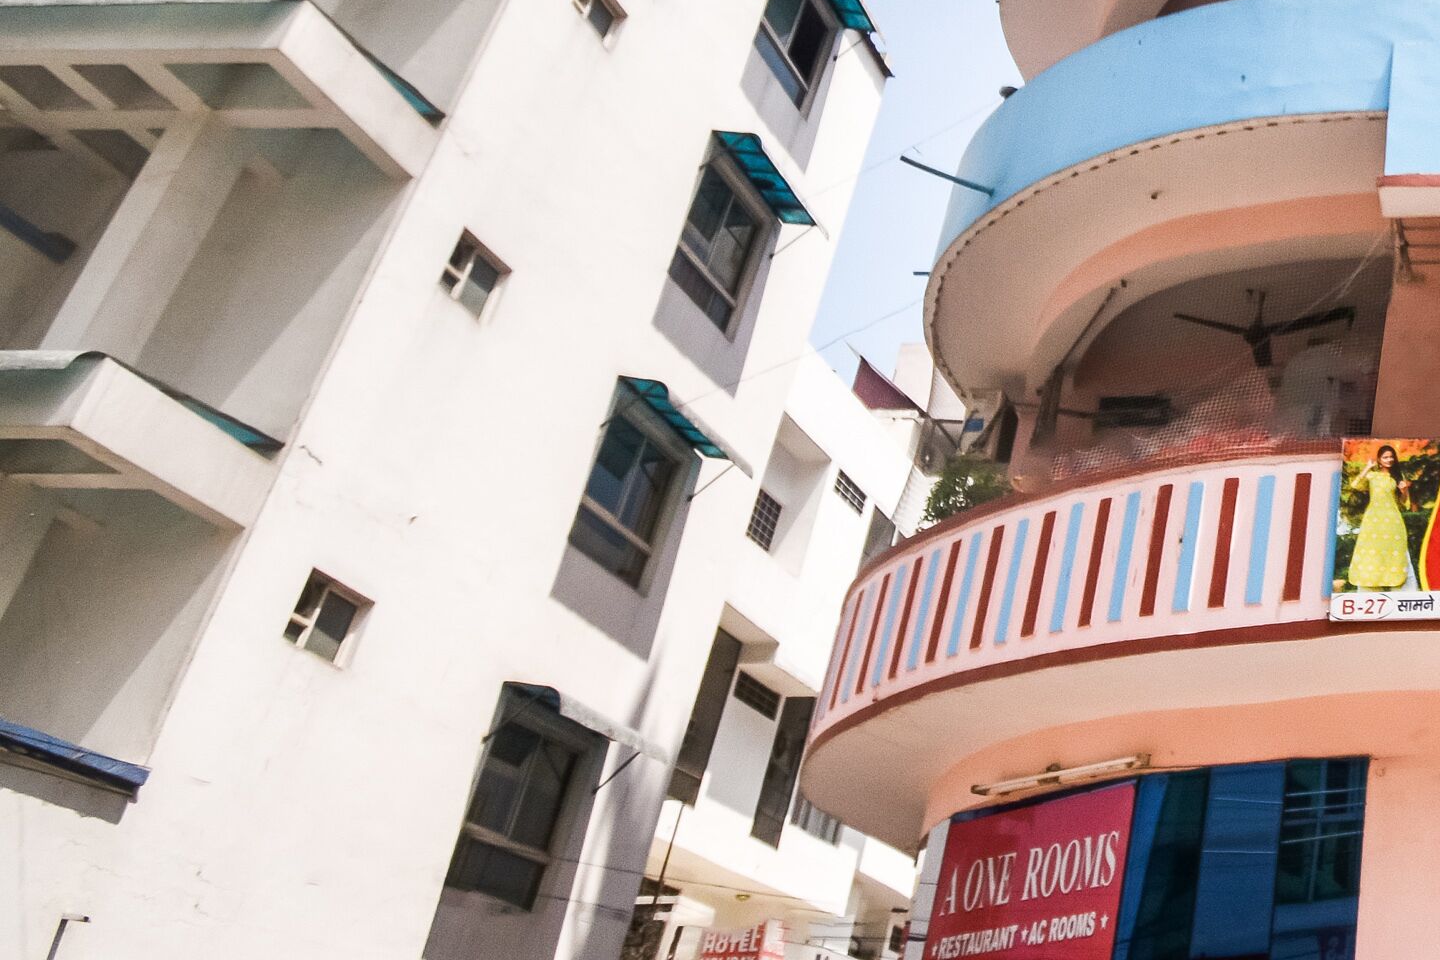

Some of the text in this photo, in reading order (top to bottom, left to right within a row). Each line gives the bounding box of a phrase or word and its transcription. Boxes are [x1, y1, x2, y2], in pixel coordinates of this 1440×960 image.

[1342, 599, 1387, 615] B-27
[938, 830, 1121, 917] A ONE ROOMS
[702, 926, 759, 954] HOTEL
[937, 911, 1097, 960] RESTAURANT AC ROOMS
